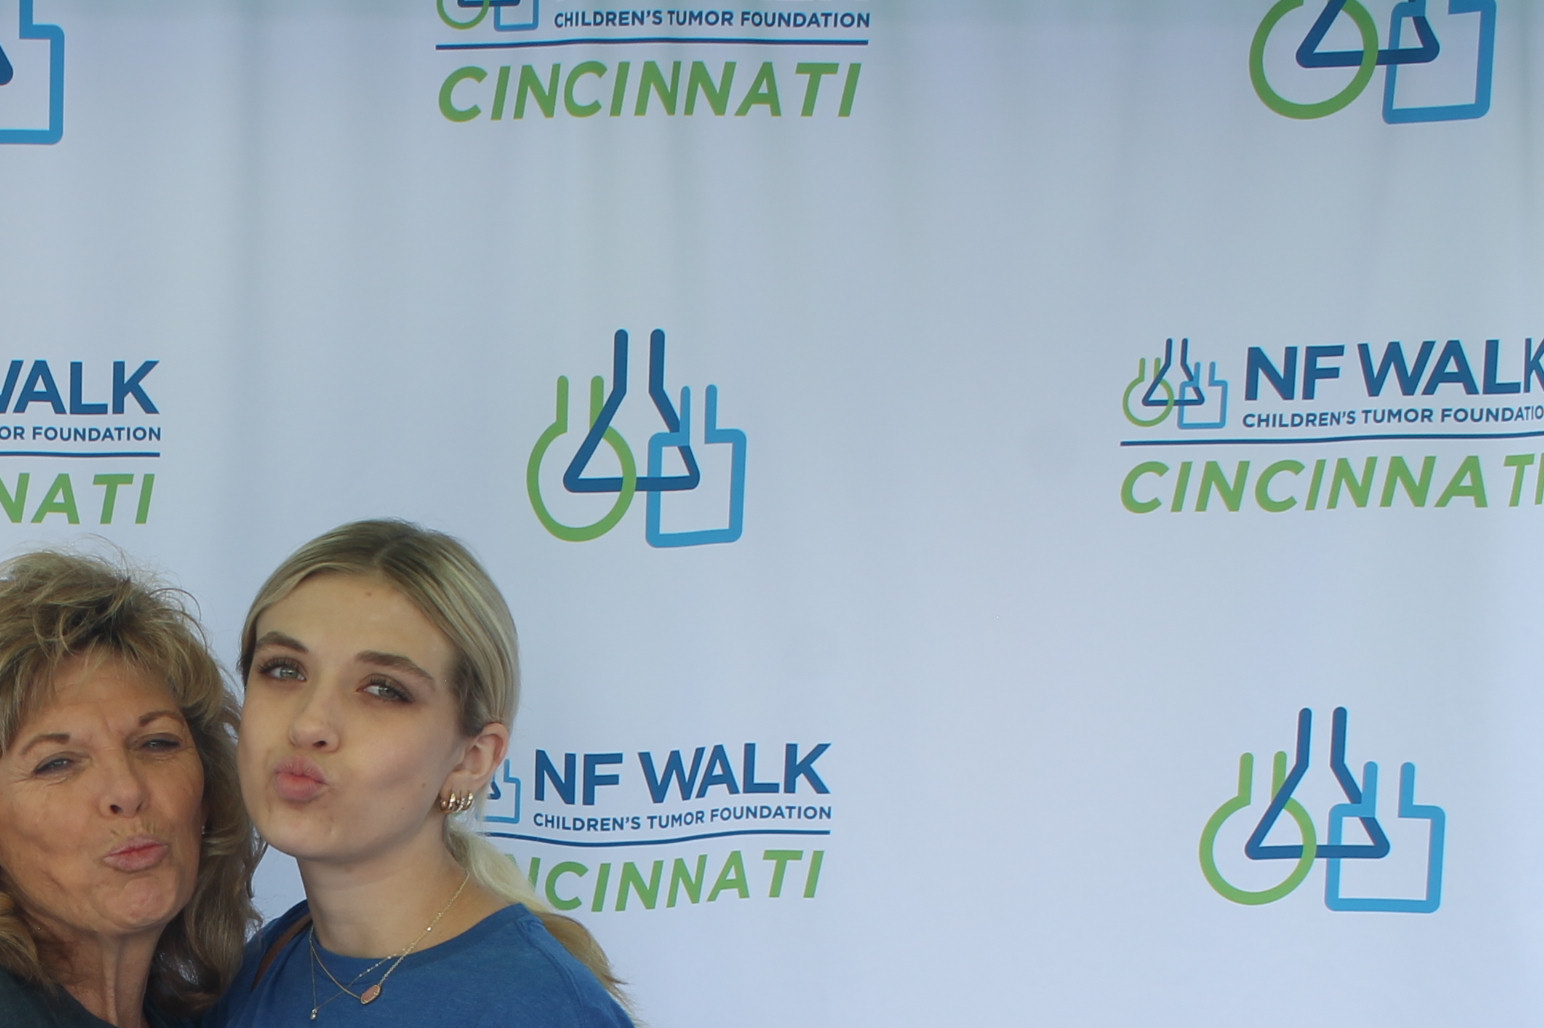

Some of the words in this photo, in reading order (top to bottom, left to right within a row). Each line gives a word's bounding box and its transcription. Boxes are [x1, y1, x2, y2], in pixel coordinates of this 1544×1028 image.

[667, 9, 734, 27] TUMOR
[740, 9, 871, 29] FOUNDATION
[438, 60, 862, 122] CINCINNATI
[1244, 345, 1345, 401] NF
[1357, 338, 1544, 397] WALK
[32, 427, 161, 442] FOUNDATION
[1361, 408, 1434, 424] TUMOR
[1121, 453, 1544, 514] CINCINNATI
[534, 749, 623, 806] NF
[638, 743, 832, 804] WALK
[646, 810, 704, 830] TUMOR
[710, 805, 832, 822] FOUNDATION
